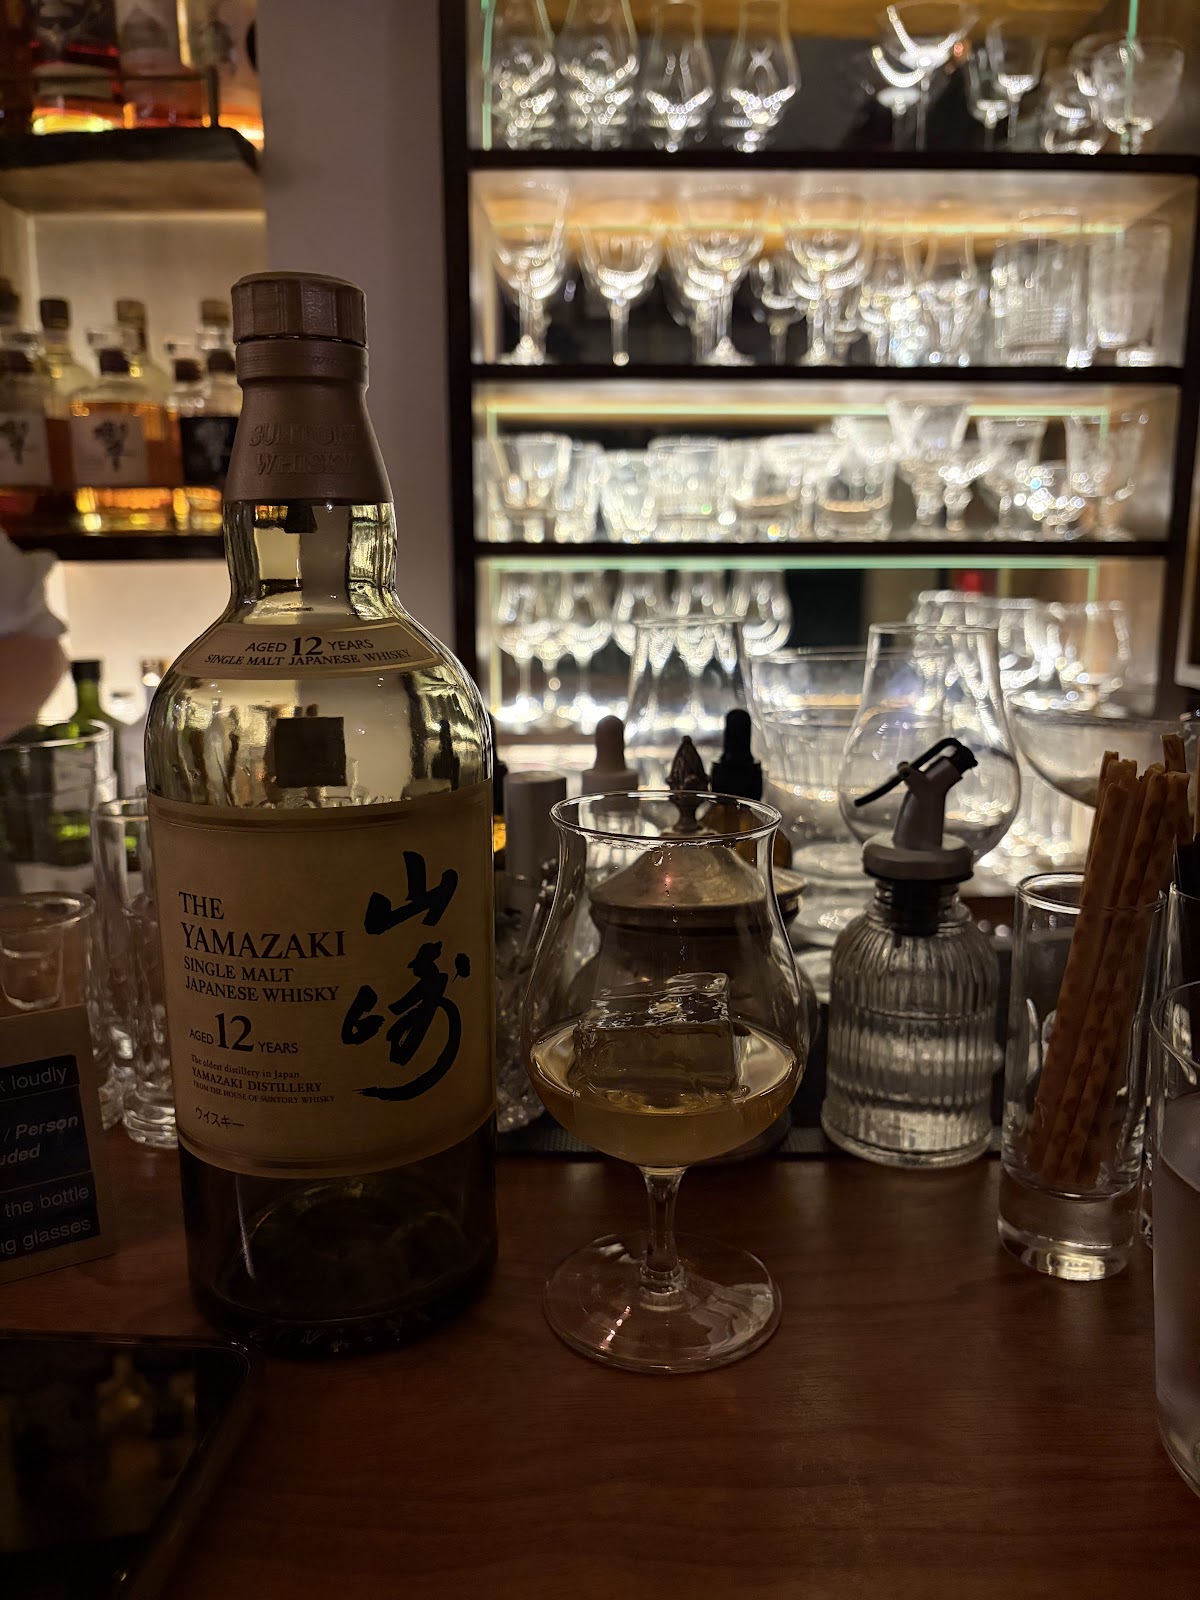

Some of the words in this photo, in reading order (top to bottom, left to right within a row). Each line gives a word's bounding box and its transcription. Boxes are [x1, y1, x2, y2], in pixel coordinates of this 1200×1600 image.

[204, 654, 243, 665] SINGLE
[246, 656, 285, 666] MALT
[288, 654, 361, 666] JAPANESE
[362, 648, 412, 662] WHISKY
[245, 642, 287, 653] AGED
[291, 636, 324, 656] 12
[327, 638, 374, 652] YEARS
[178, 891, 224, 920] THE
[180, 921, 346, 960] YAMAZAKI
[184, 955, 236, 980] SINGLE
[241, 966, 294, 983] MALT
[185, 975, 259, 1002] JAPANESE
[261, 985, 340, 1003] WHISKY
[189, 1028, 214, 1045] AGED
[215, 1012, 255, 1052] 12
[257, 1041, 299, 1054] YEARS
[11, 1066, 67, 1090] loudly
[190, 1054, 202, 1065] The
[202, 1059, 223, 1071] oldest
[224, 1064, 260, 1078] distillery
[262, 1070, 272, 1078] in
[274, 1070, 300, 1081] Japan
[192, 1066, 243, 1089] YAMAZAKI
[247, 1080, 322, 1093] DISTILLERY
[193, 1080, 209, 1092] FROM
[210, 1086, 222, 1096] THE
[223, 1090, 247, 1100] HOUSE
[248, 1094, 258, 1102] OF
[260, 1095, 298, 1104] SUNTORY
[301, 1095, 336, 1104] WHISKY
[16, 1114, 80, 1140] Person
[195, 1106, 245, 1130] ウイスキー
[4, 1199, 34, 1218] the
[40, 1186, 90, 1209] bottle
[22, 1218, 92, 1251] glasses
